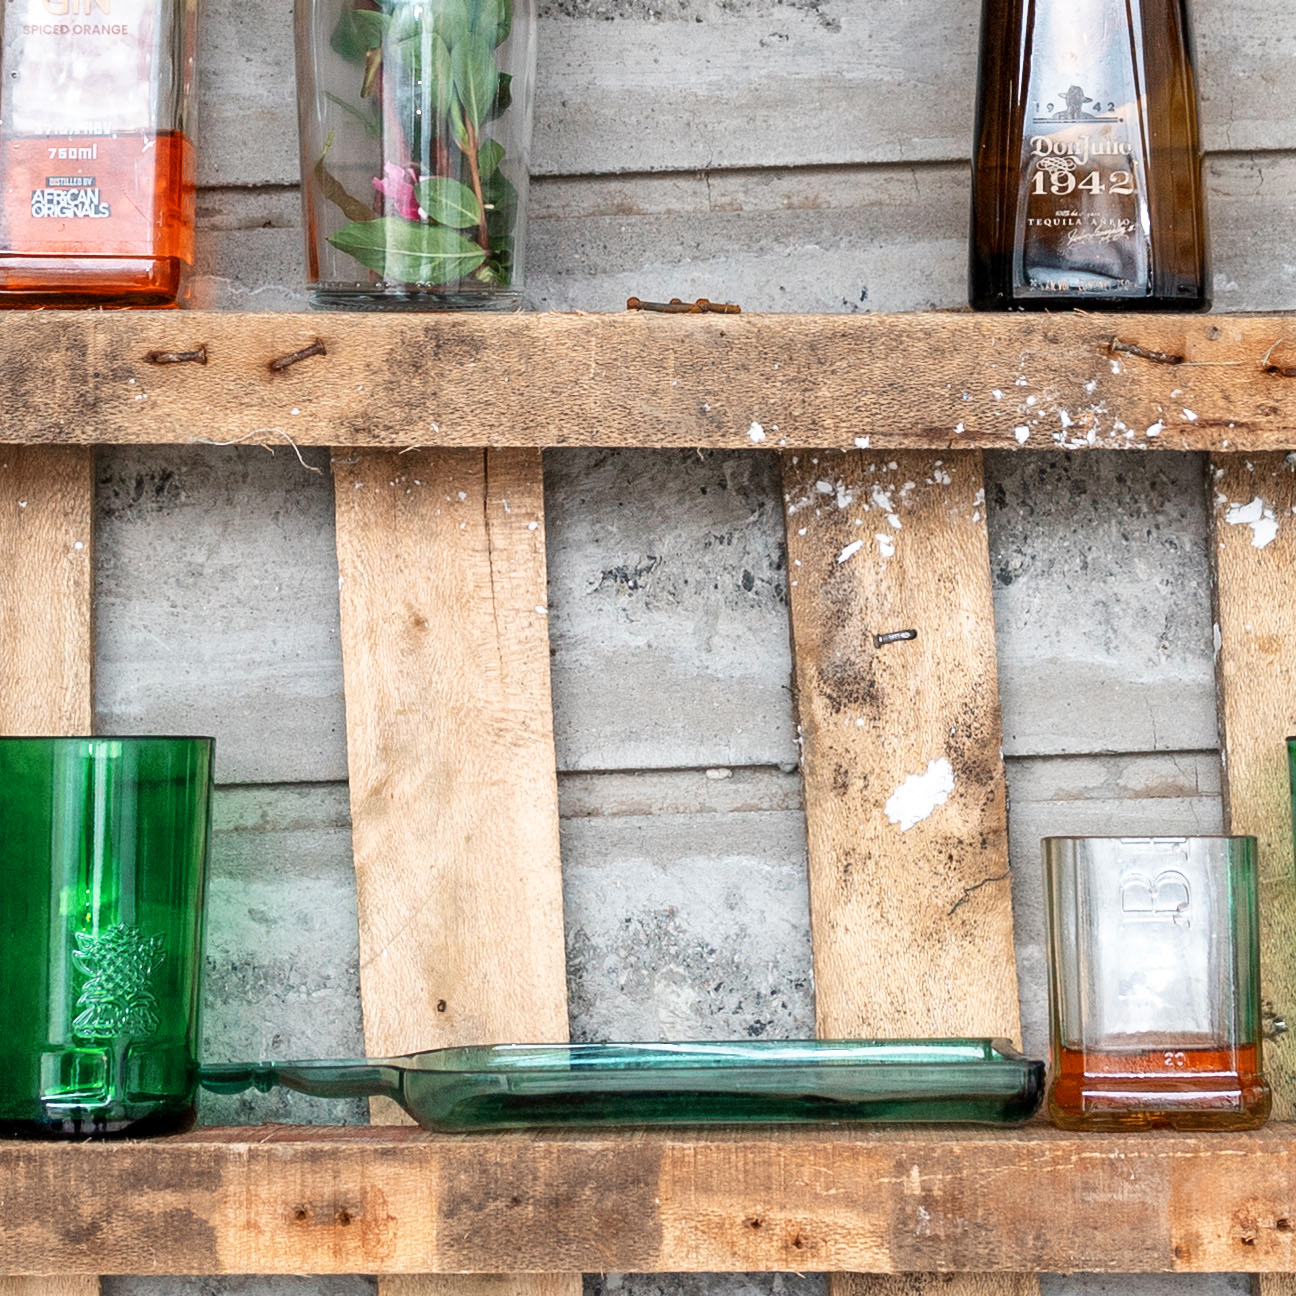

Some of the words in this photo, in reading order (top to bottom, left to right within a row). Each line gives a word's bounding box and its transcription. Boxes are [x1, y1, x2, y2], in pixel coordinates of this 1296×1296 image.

[23, 24, 70, 36] SPICED
[72, 24, 129, 36] ORANGE
[1030, 135, 1081, 157] Don
[1070, 135, 1133, 166] Julio
[1031, 170, 1135, 196] 1942
[31, 187, 100, 205] AFRICAN
[31, 202, 111, 219] ORIGINALS
[1028, 217, 1082, 227] TEQUILA
